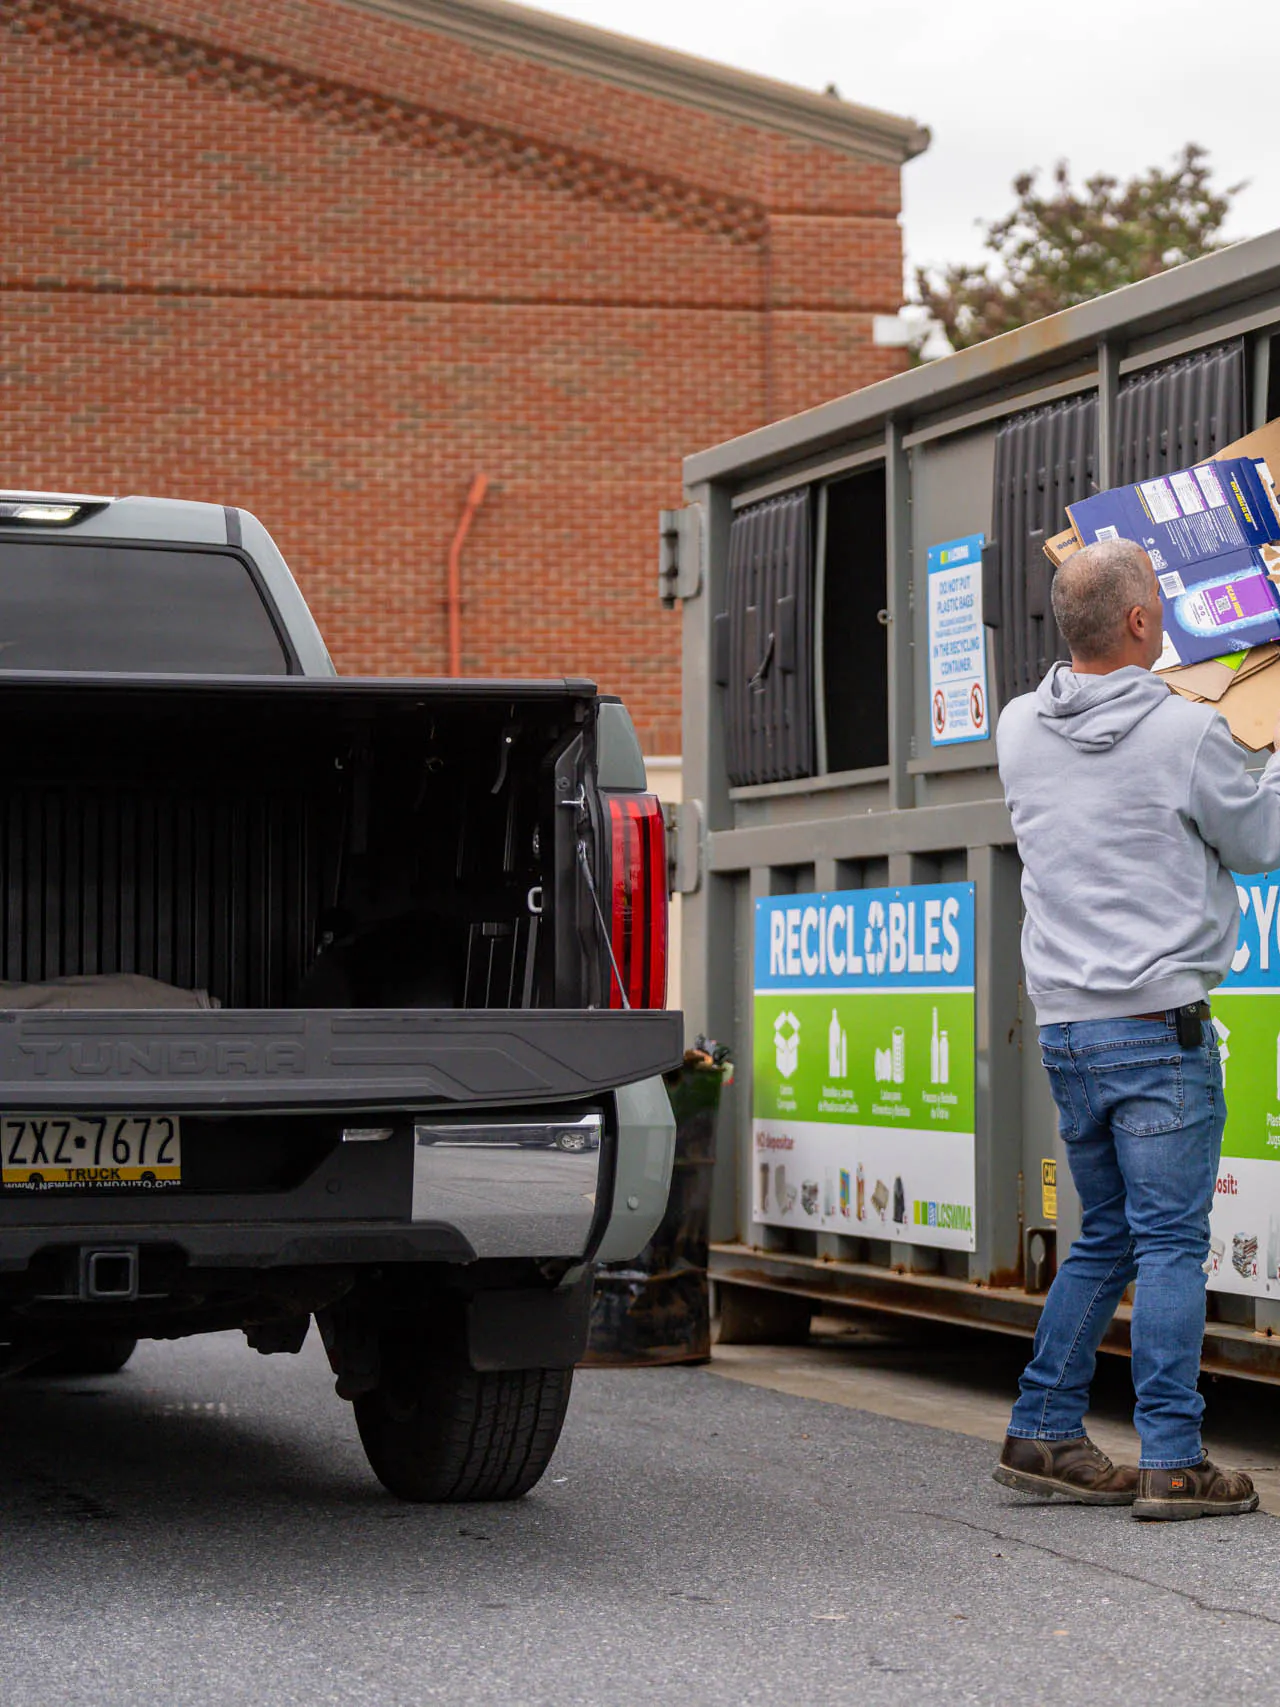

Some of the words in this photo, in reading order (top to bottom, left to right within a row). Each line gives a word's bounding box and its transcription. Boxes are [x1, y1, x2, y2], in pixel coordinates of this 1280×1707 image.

[17, 1040, 306, 1076] TUNDRA
[1266, 1132, 1280, 1149] Jugs
[64, 1168, 121, 1180] TRUCK
